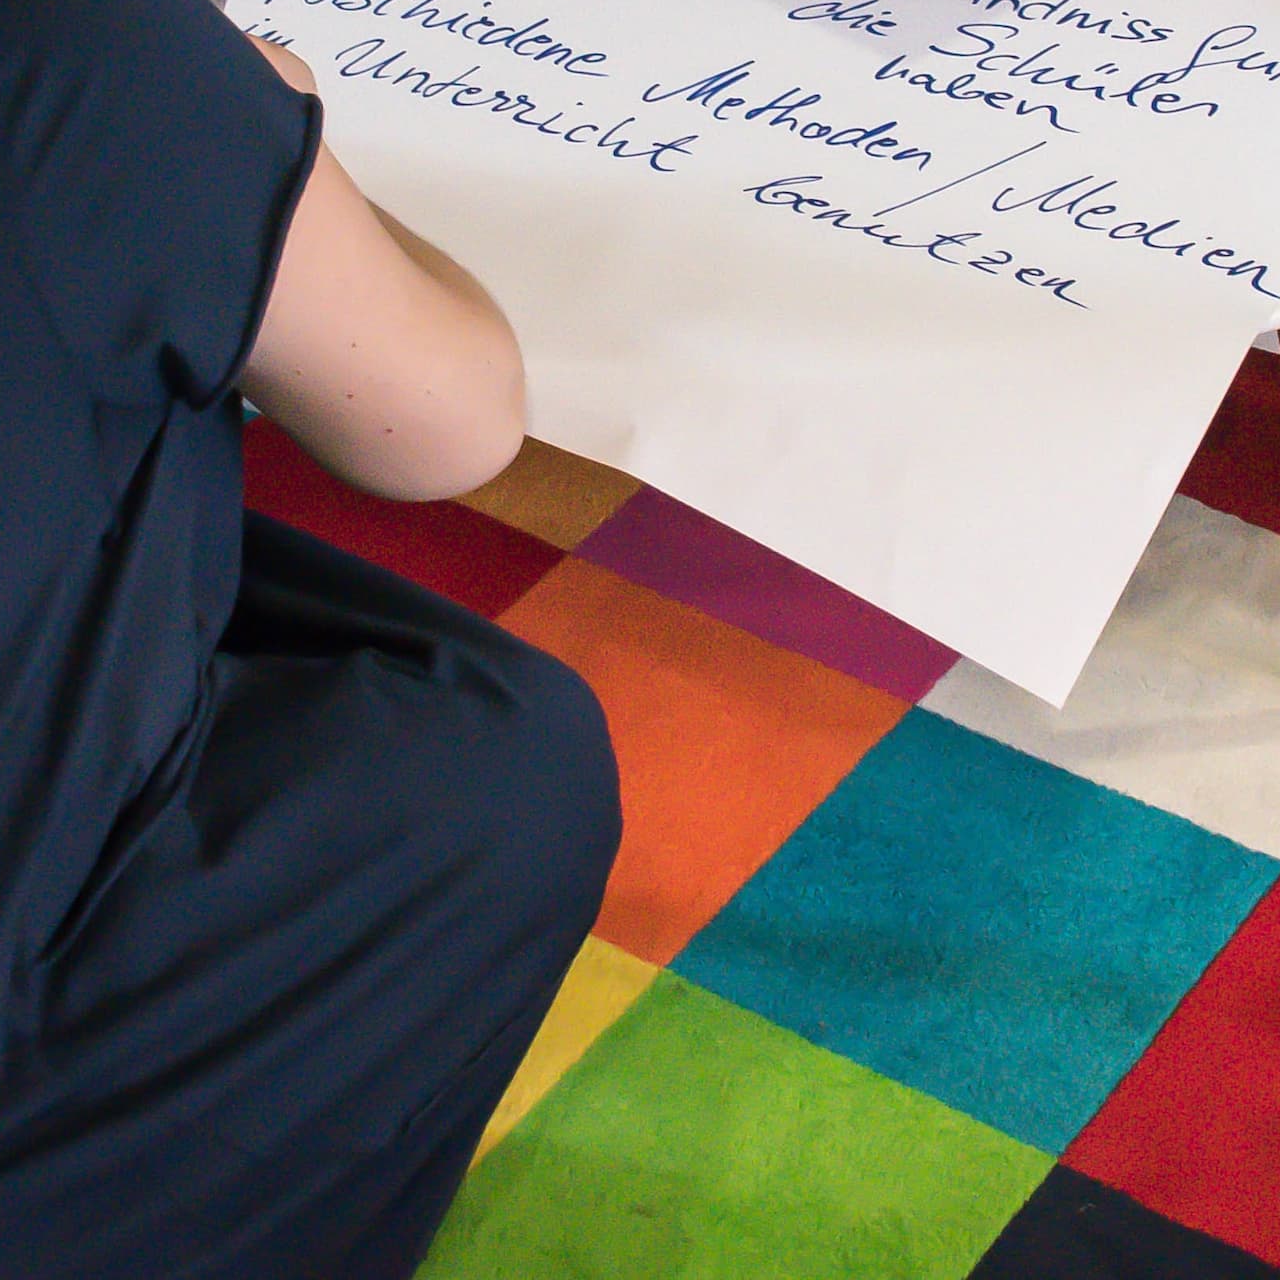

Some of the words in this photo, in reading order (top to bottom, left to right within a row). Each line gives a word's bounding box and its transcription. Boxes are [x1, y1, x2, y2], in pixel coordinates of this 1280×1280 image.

[641, 59, 933, 173] Methoden
[874, 54, 1082, 135] haben
[928, 23, 1220, 119] Schüler
[334, 37, 700, 174] Unterricht
[742, 175, 1091, 310] benutzen
